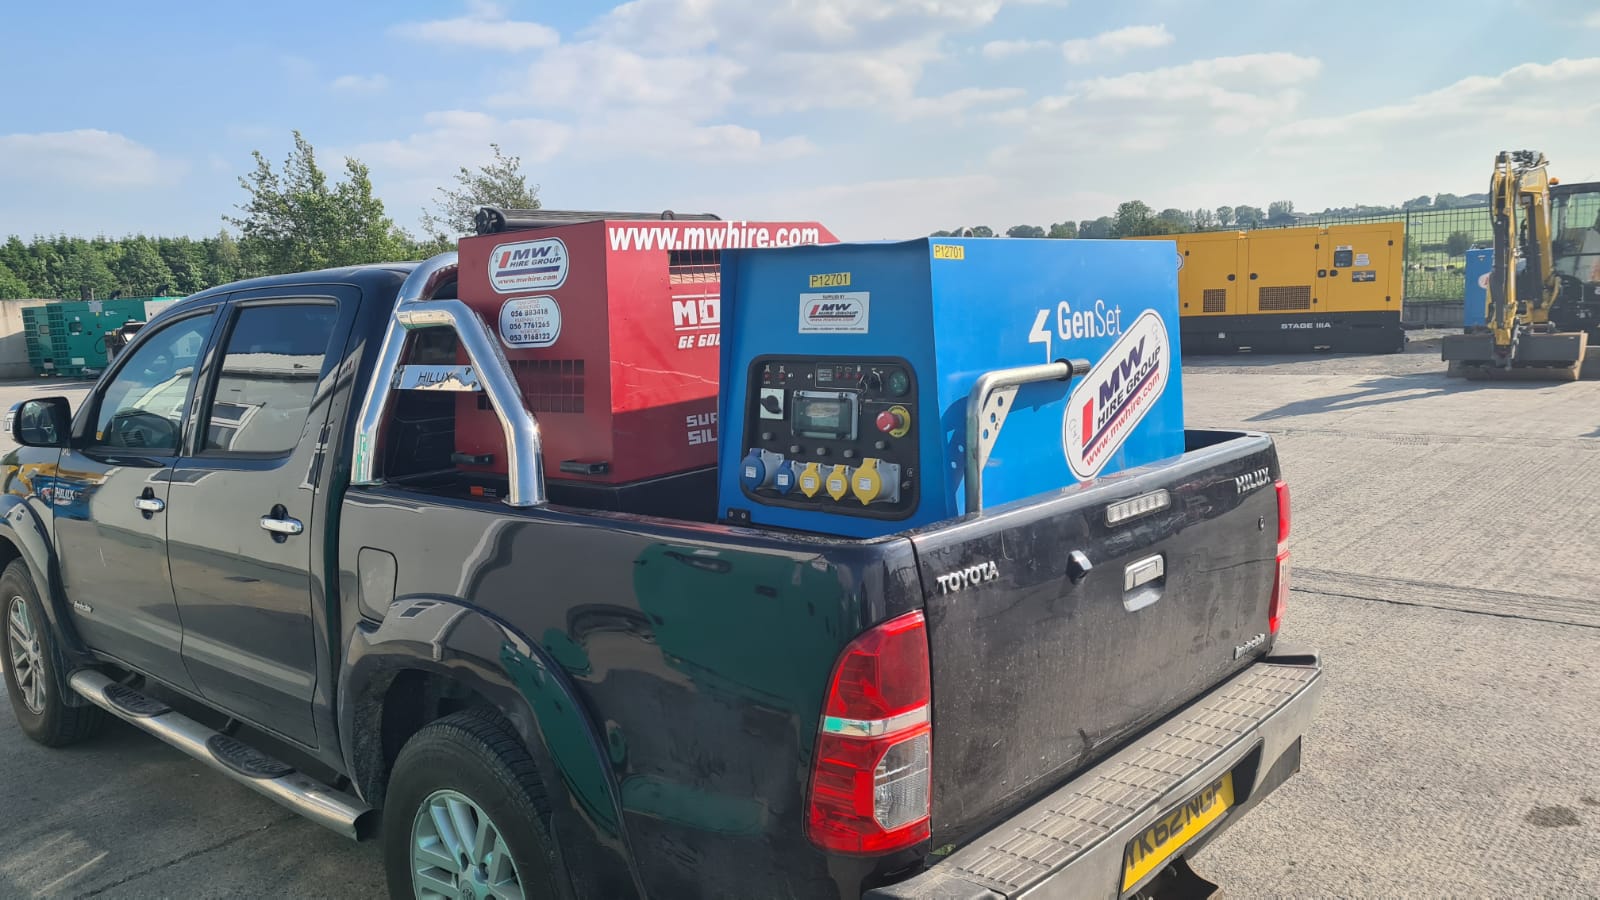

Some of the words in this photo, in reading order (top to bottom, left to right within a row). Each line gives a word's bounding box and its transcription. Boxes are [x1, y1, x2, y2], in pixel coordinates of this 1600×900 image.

[608, 220, 819, 250] www.mwhire.com
[512, 246, 552, 261] MW
[935, 245, 963, 258] P12701
[510, 260, 529, 268] HIRE
[531, 256, 562, 266] GROUP
[811, 273, 848, 287] P12701
[510, 310, 522, 318] 056
[821, 303, 852, 311] MW
[1057, 300, 1123, 341] GenSet
[678, 335, 695, 349] GE
[418, 371, 453, 383] HILUX
[1099, 335, 1146, 411] MW
[1097, 395, 1124, 430] HIRE
[1126, 346, 1161, 395] GROUP
[1086, 372, 1160, 467] www.mwhire.com
[1235, 466, 1270, 494] HILUX
[936, 560, 999, 595] TOYOTA
